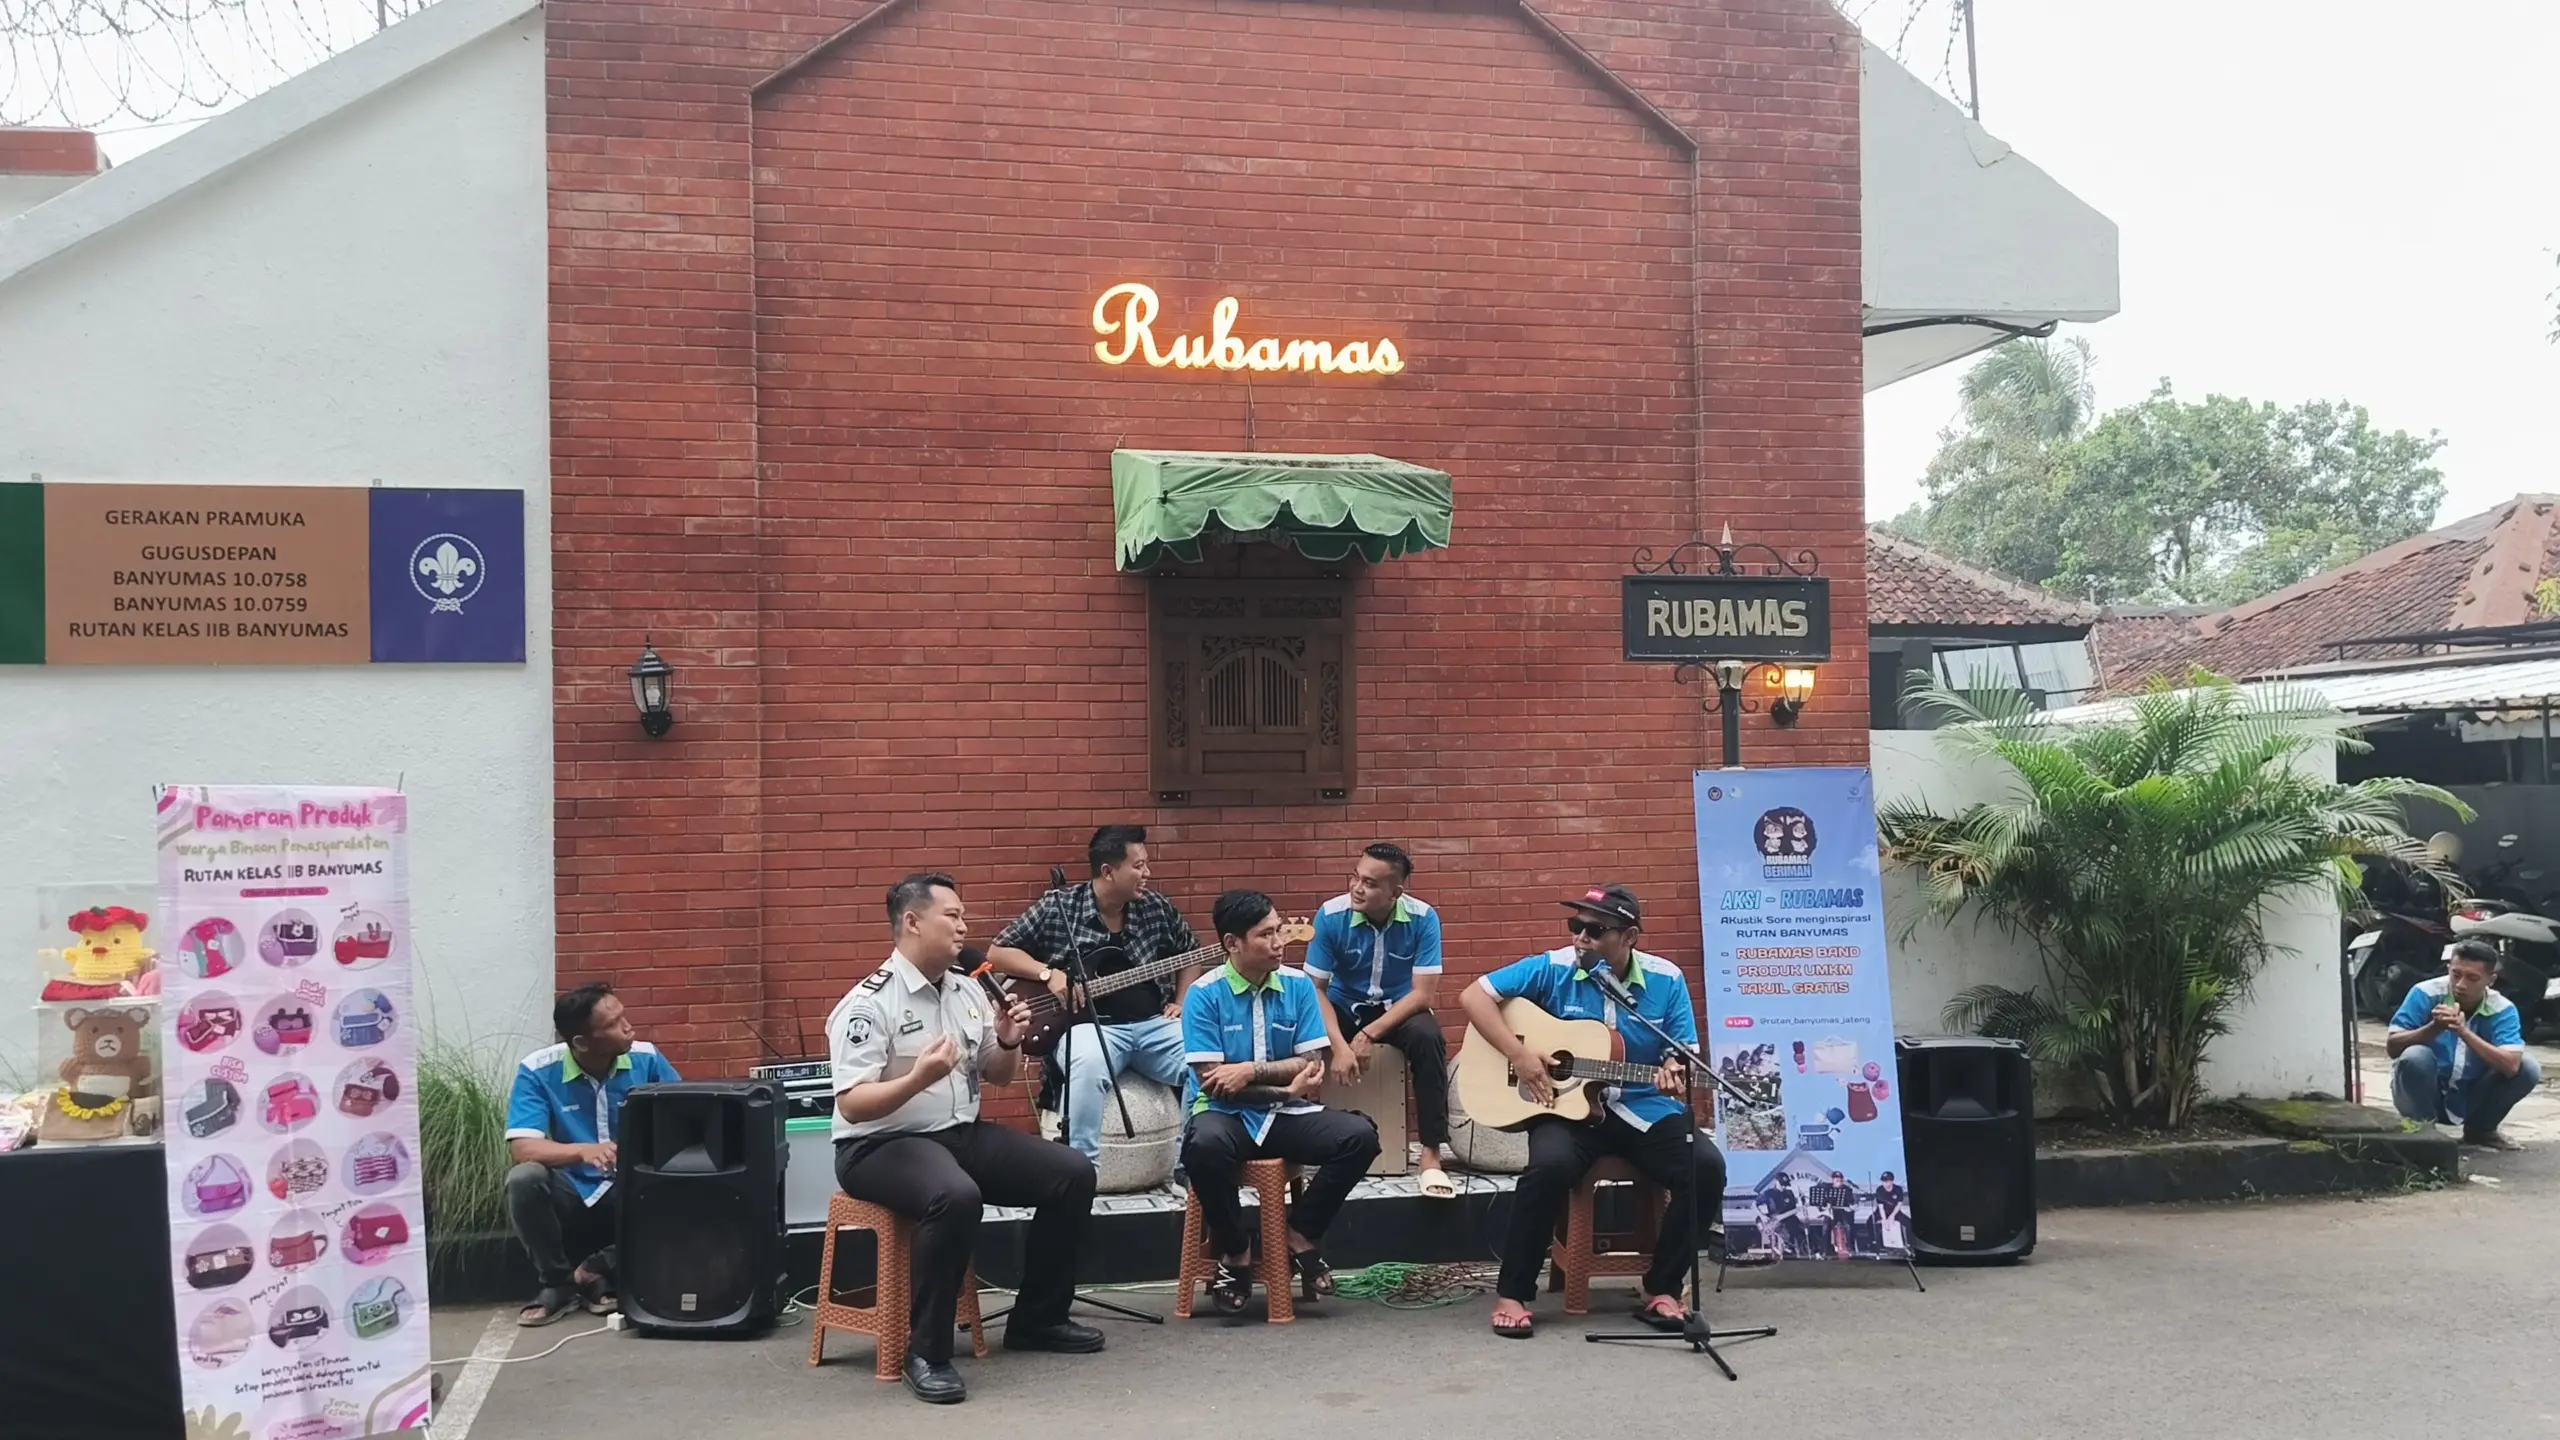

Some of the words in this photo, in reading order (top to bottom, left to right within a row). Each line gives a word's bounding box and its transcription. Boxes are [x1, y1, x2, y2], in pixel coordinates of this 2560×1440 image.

[1092, 282, 1405, 375] Rubamas
[105, 509, 199, 526] GERAKAN
[206, 511, 305, 527] PRAMUKA
[141, 545, 277, 561] GUGUSDEPAN
[113, 570, 226, 587] BANYUMAS
[233, 571, 307, 588] 10.0758
[113, 595, 227, 612] BANYUMAS
[233, 596, 307, 613] 10.0759
[1647, 598, 1809, 638] RUBAMAS
[69, 621, 136, 637] RUTAN
[142, 621, 200, 637] KELAS
[206, 622, 230, 637] IIB
[237, 622, 348, 638] BANYUMAS
[196, 805, 293, 830] Pameran
[300, 802, 372, 830] Produk
[230, 839, 276, 856] Binaan
[1766, 854, 1808, 865] RUBAMAS
[184, 869, 232, 882] RUTAN
[237, 865, 282, 880] KELAS
[308, 861, 383, 877] BANYUMAS
[1764, 865, 1812, 878] BERIMAN
[1721, 889, 1762, 910] AKSI
[1780, 888, 1864, 909] RUBAMAS
[1767, 915, 1792, 924] Sore
[1736, 929, 1776, 938] RUTAN
[1780, 927, 1849, 937] BANYUMAS
[1736, 947, 1813, 960] RUBAMAS
[1816, 945, 1861, 958] BAND
[1737, 965, 1802, 977] PRODUK
[1804, 963, 1853, 977] UMKM
[1738, 982, 1790, 995] TAKJIL
[1793, 981, 1850, 994] GRATIS
